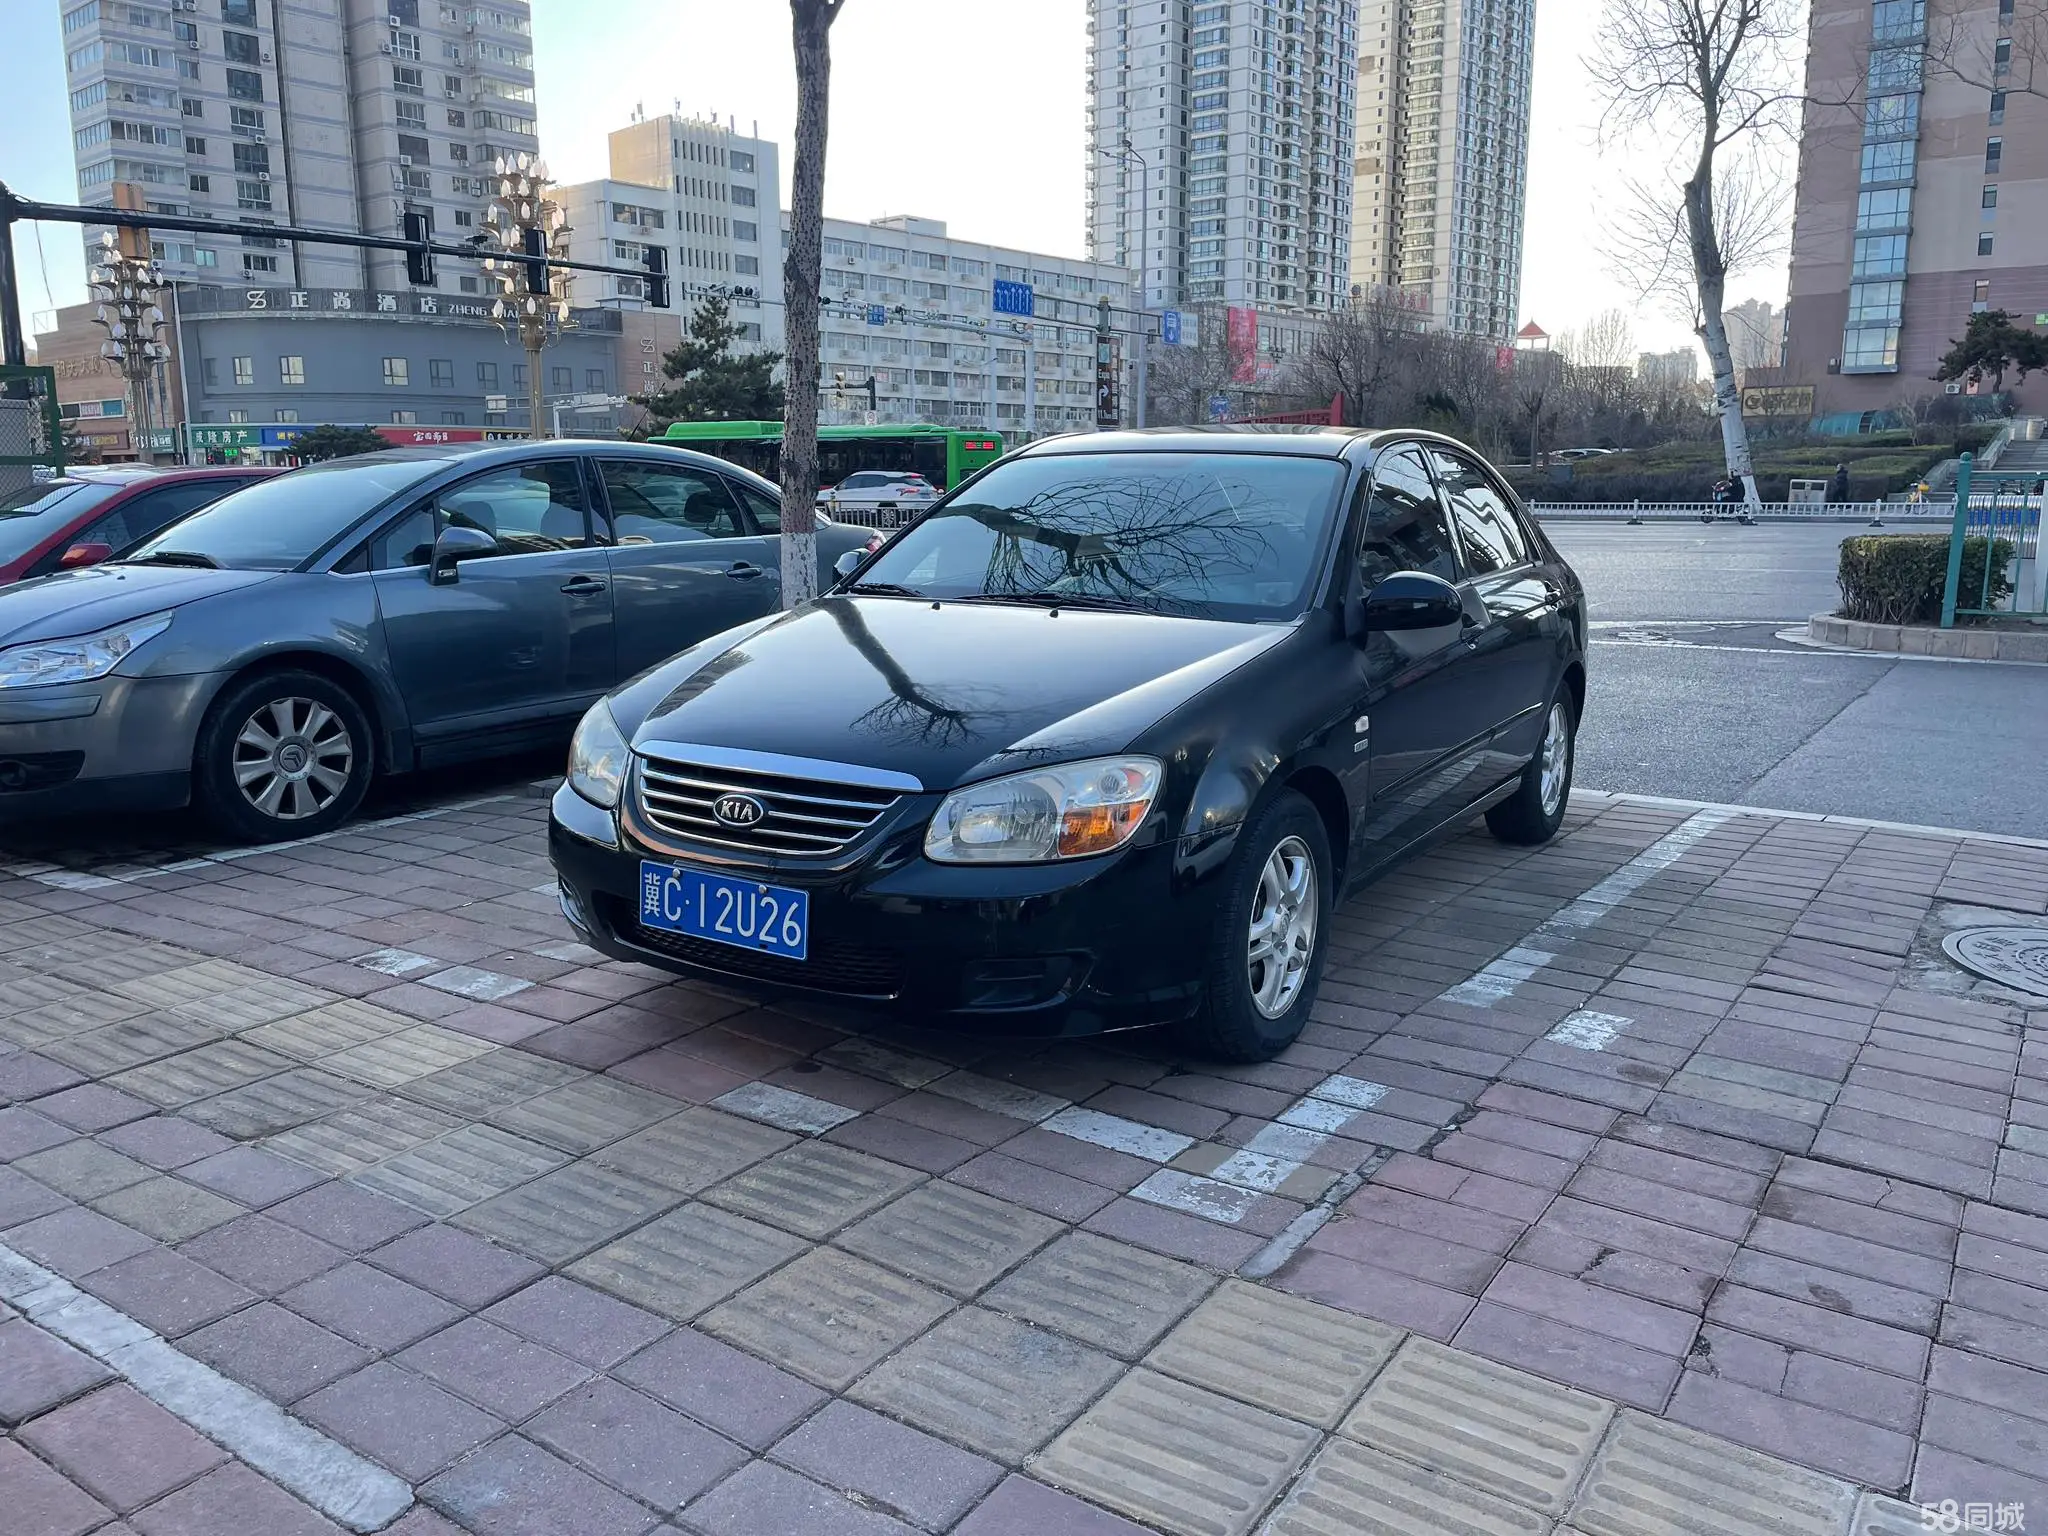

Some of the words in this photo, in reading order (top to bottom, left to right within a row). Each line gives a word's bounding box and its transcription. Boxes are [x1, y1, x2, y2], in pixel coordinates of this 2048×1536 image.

[290, 291, 437, 314] 正尚酒店
[449, 304, 487, 316] ZHENG
[720, 800, 753, 821] KIA
